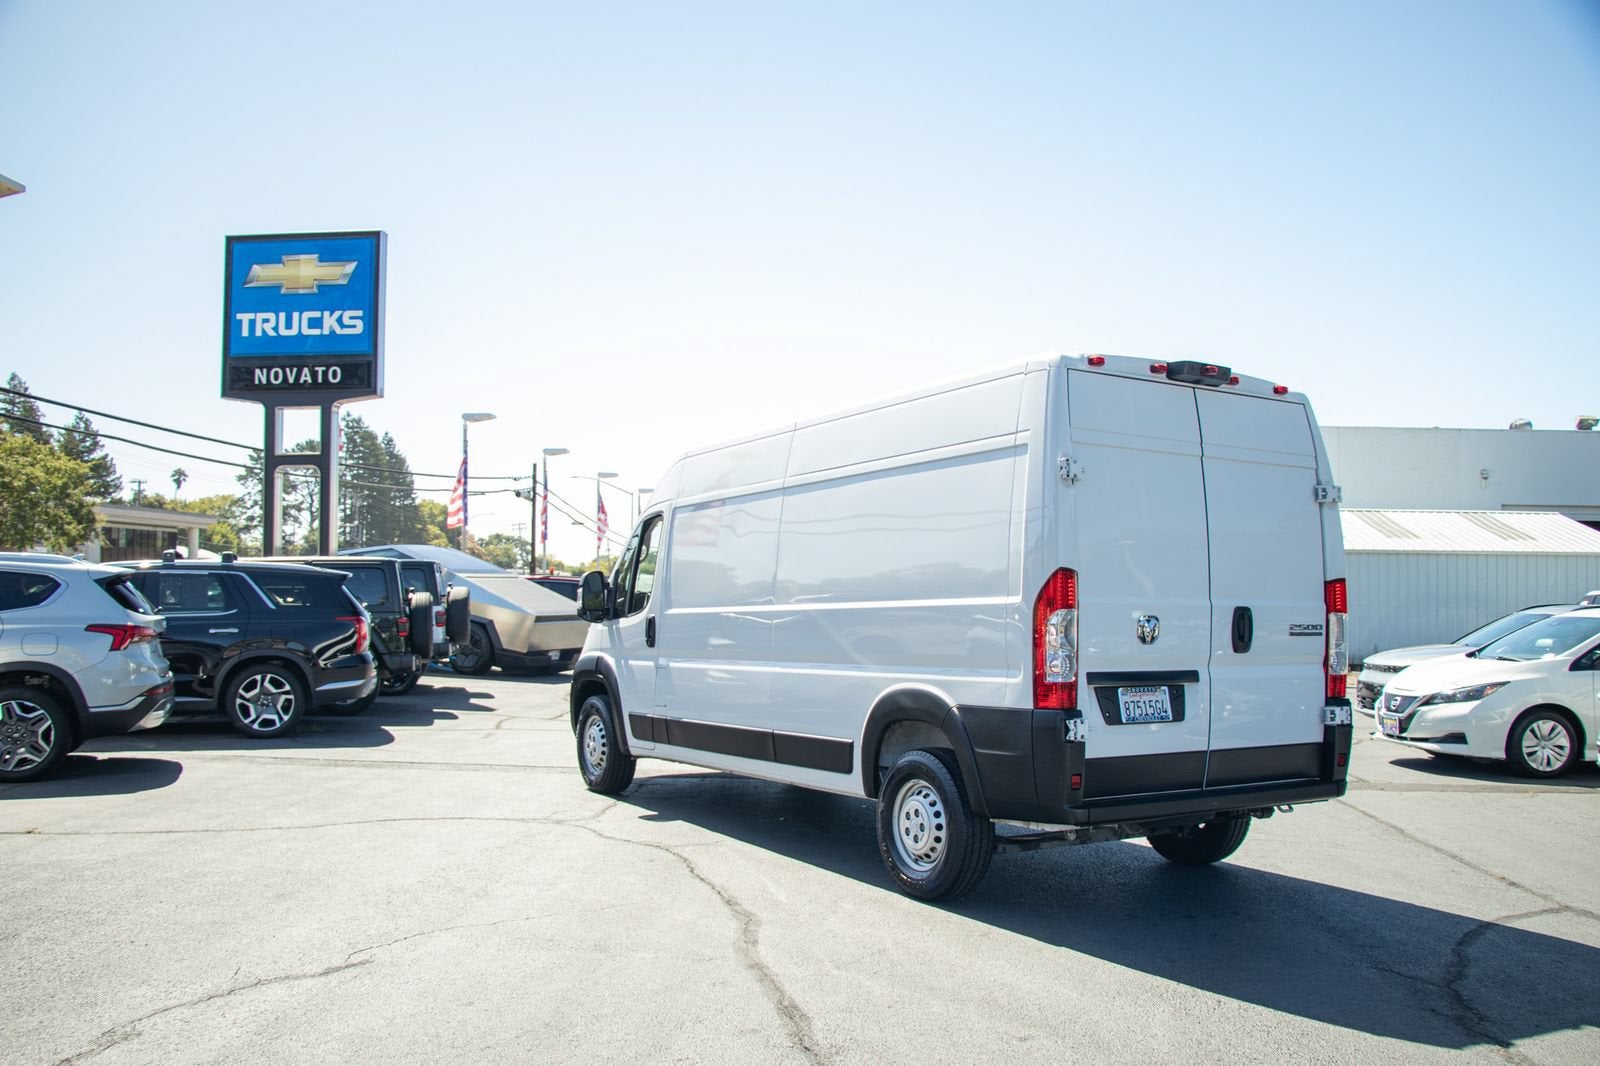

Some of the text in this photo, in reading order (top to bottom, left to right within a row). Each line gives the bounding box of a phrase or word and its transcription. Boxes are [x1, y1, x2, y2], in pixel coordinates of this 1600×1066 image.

[236, 310, 364, 337] TRUCKS
[254, 366, 341, 384] NOVATO
[1124, 700, 1168, 717] 87515G4
